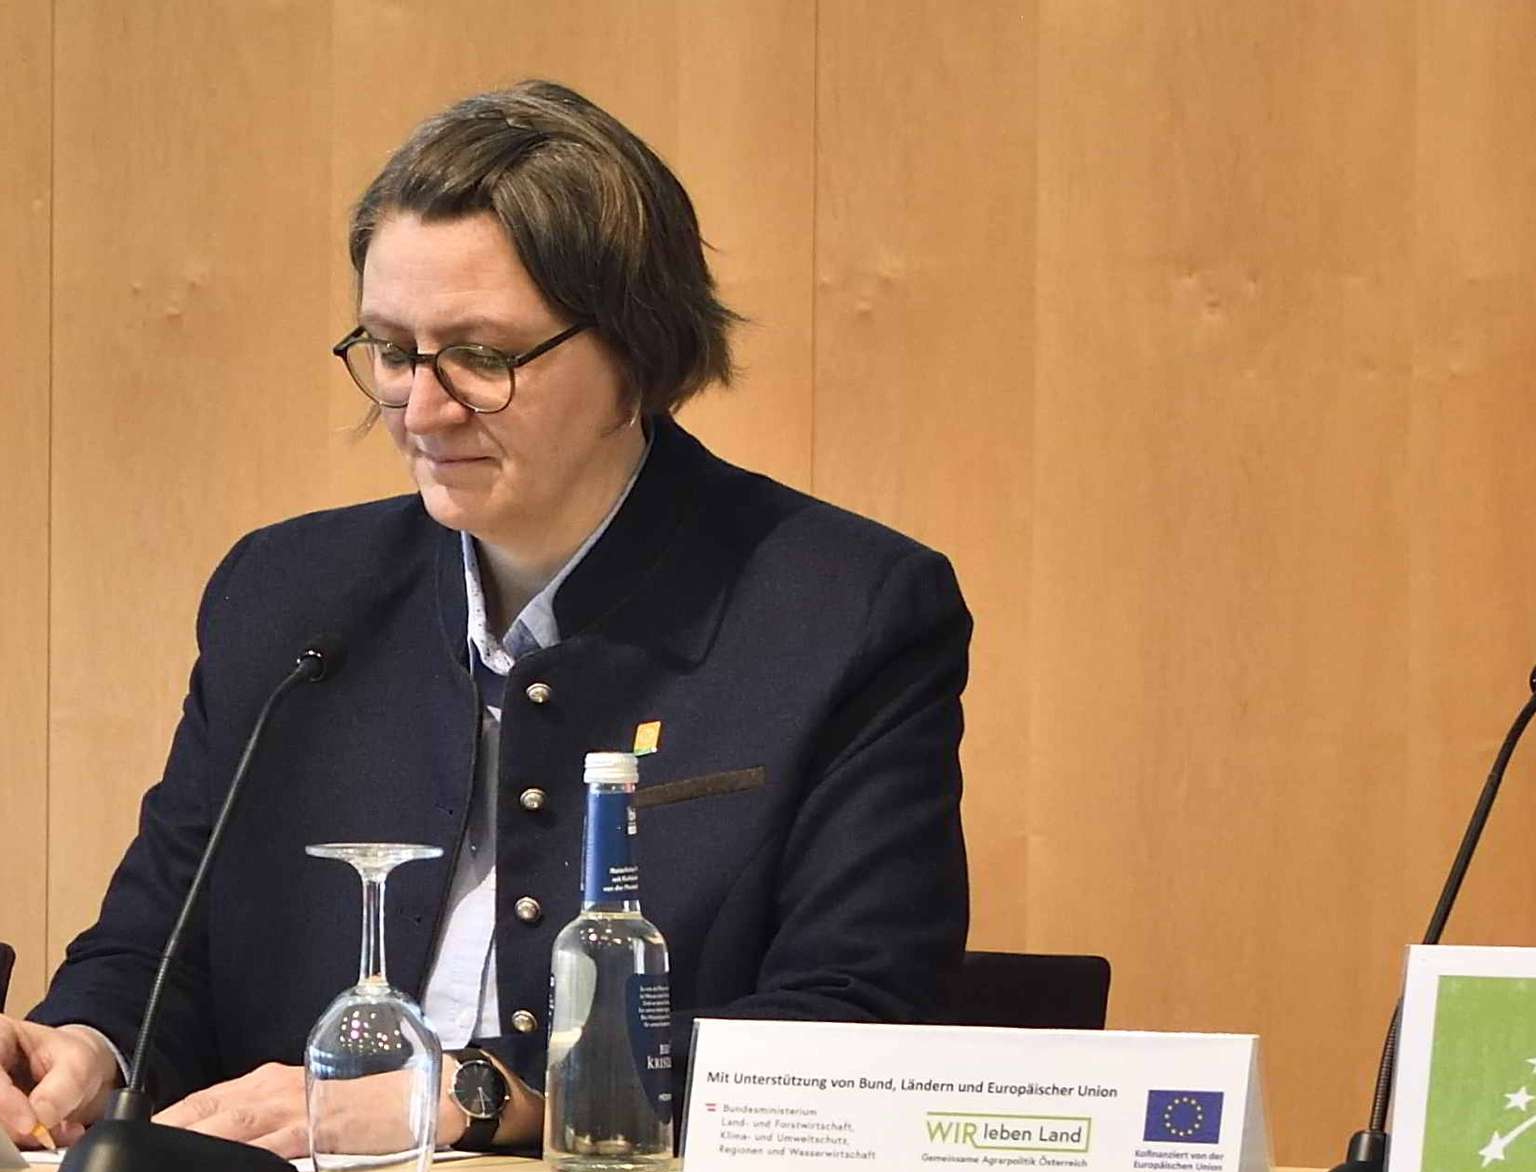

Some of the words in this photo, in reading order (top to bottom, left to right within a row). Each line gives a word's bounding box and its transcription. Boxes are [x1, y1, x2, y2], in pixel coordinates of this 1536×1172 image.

[707, 1071, 729, 1084] Mit
[734, 1073, 827, 1090] Unterstützung
[831, 1078, 855, 1088] von
[859, 1077, 896, 1091] Bund,
[901, 1079, 954, 1092] Ländern
[958, 1081, 983, 1093] und
[988, 1082, 1074, 1097] Europäischer
[1078, 1085, 1118, 1098] Union
[723, 1104, 817, 1116] Bundesministerium
[721, 1118, 748, 1127] Land-
[753, 1119, 771, 1128] und
[775, 1120, 854, 1132] Forstwirtschaft,
[720, 1131, 749, 1140] Klima-
[755, 1133, 772, 1142] und
[926, 1120, 977, 1145] WIR
[983, 1123, 1032, 1141] leben
[1039, 1125, 1082, 1143] Land
[719, 1145, 763, 1156] Regionen
[767, 1146, 785, 1156] und
[790, 1147, 876, 1160] Wasserwirtschaft
[1135, 1150, 1188, 1159] Kofinanziert
[1208, 1152, 1224, 1160] der
[921, 1153, 979, 1164] Gemeinsame
[982, 1155, 1036, 1167] Agrarpolitik
[1038, 1156, 1088, 1168] Österreich
[1133, 1160, 1193, 1170] Europäischen
[1195, 1163, 1222, 1171] Union
